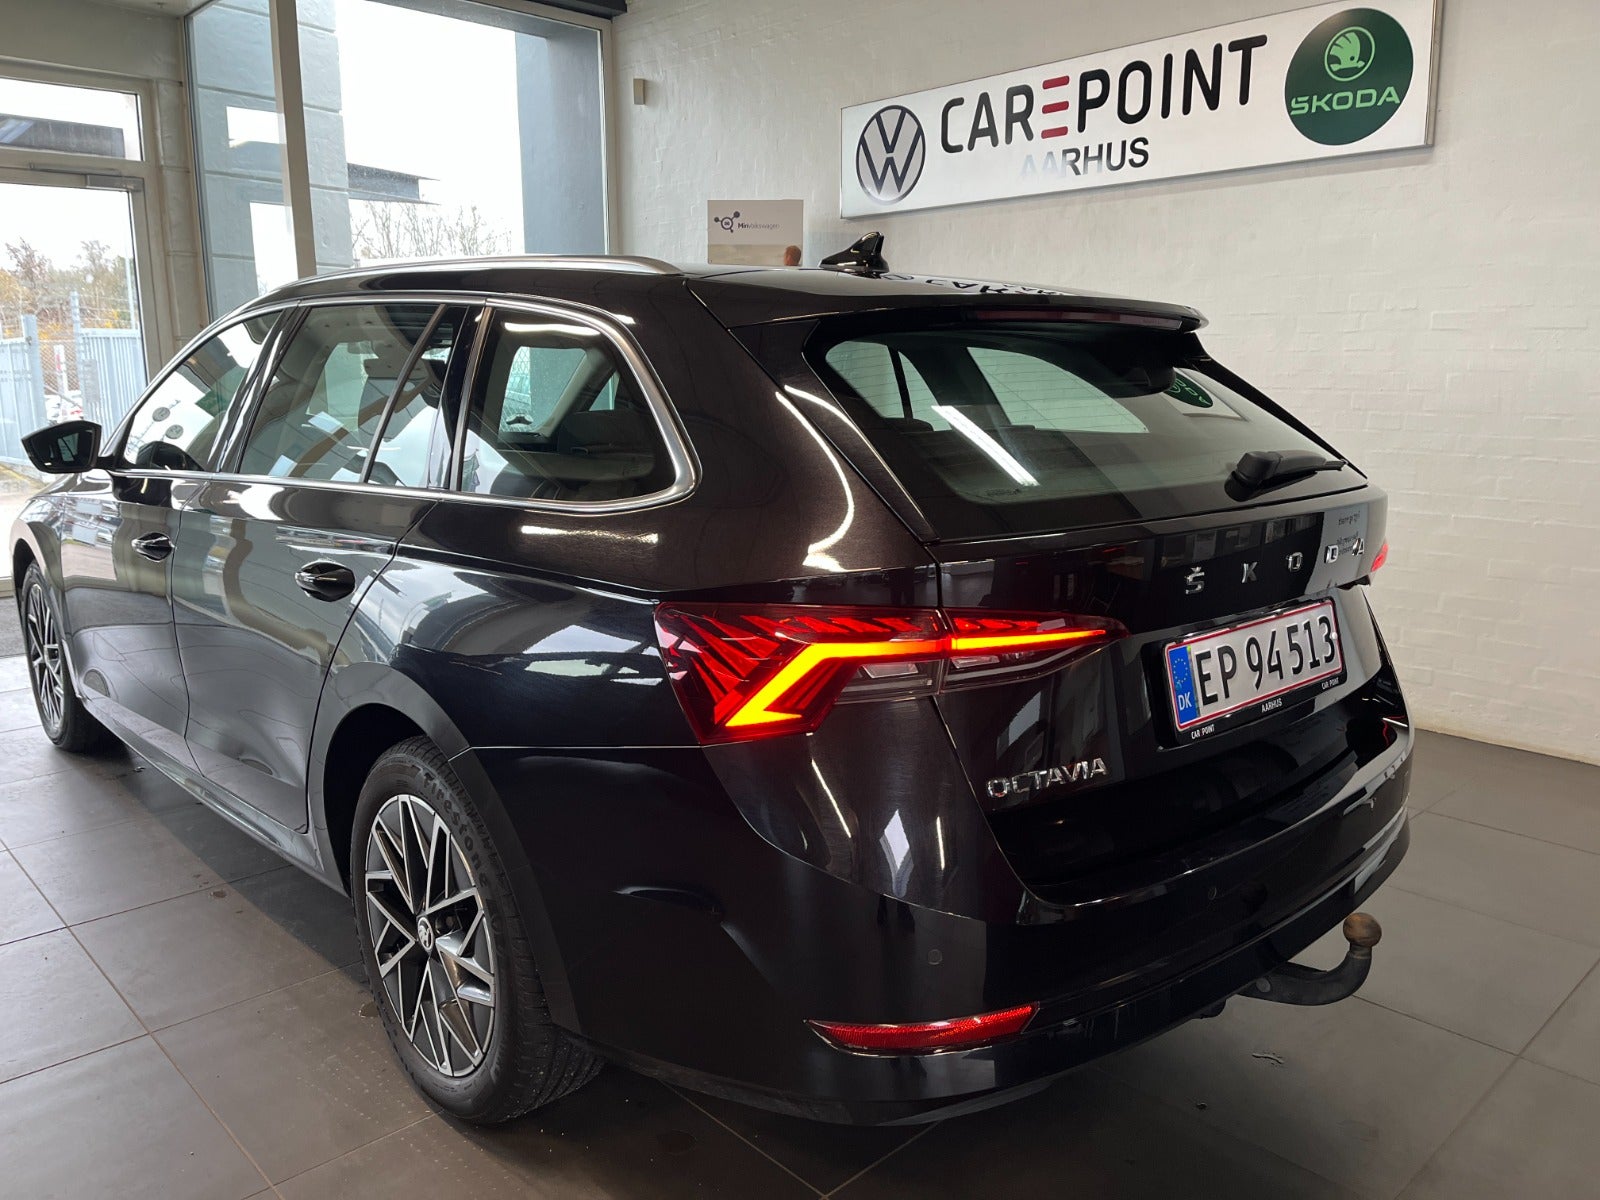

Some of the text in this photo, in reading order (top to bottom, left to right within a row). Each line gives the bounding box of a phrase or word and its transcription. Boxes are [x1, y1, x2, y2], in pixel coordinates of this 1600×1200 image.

[1020, 136, 1150, 178] AARHUS
[1196, 615, 1336, 706] EP 94513
[1178, 692, 1192, 711] DK
[1261, 698, 1283, 713] AARHUS
[1191, 724, 1215, 740] CAR POINT
[986, 757, 1107, 798] OCTAVIA
